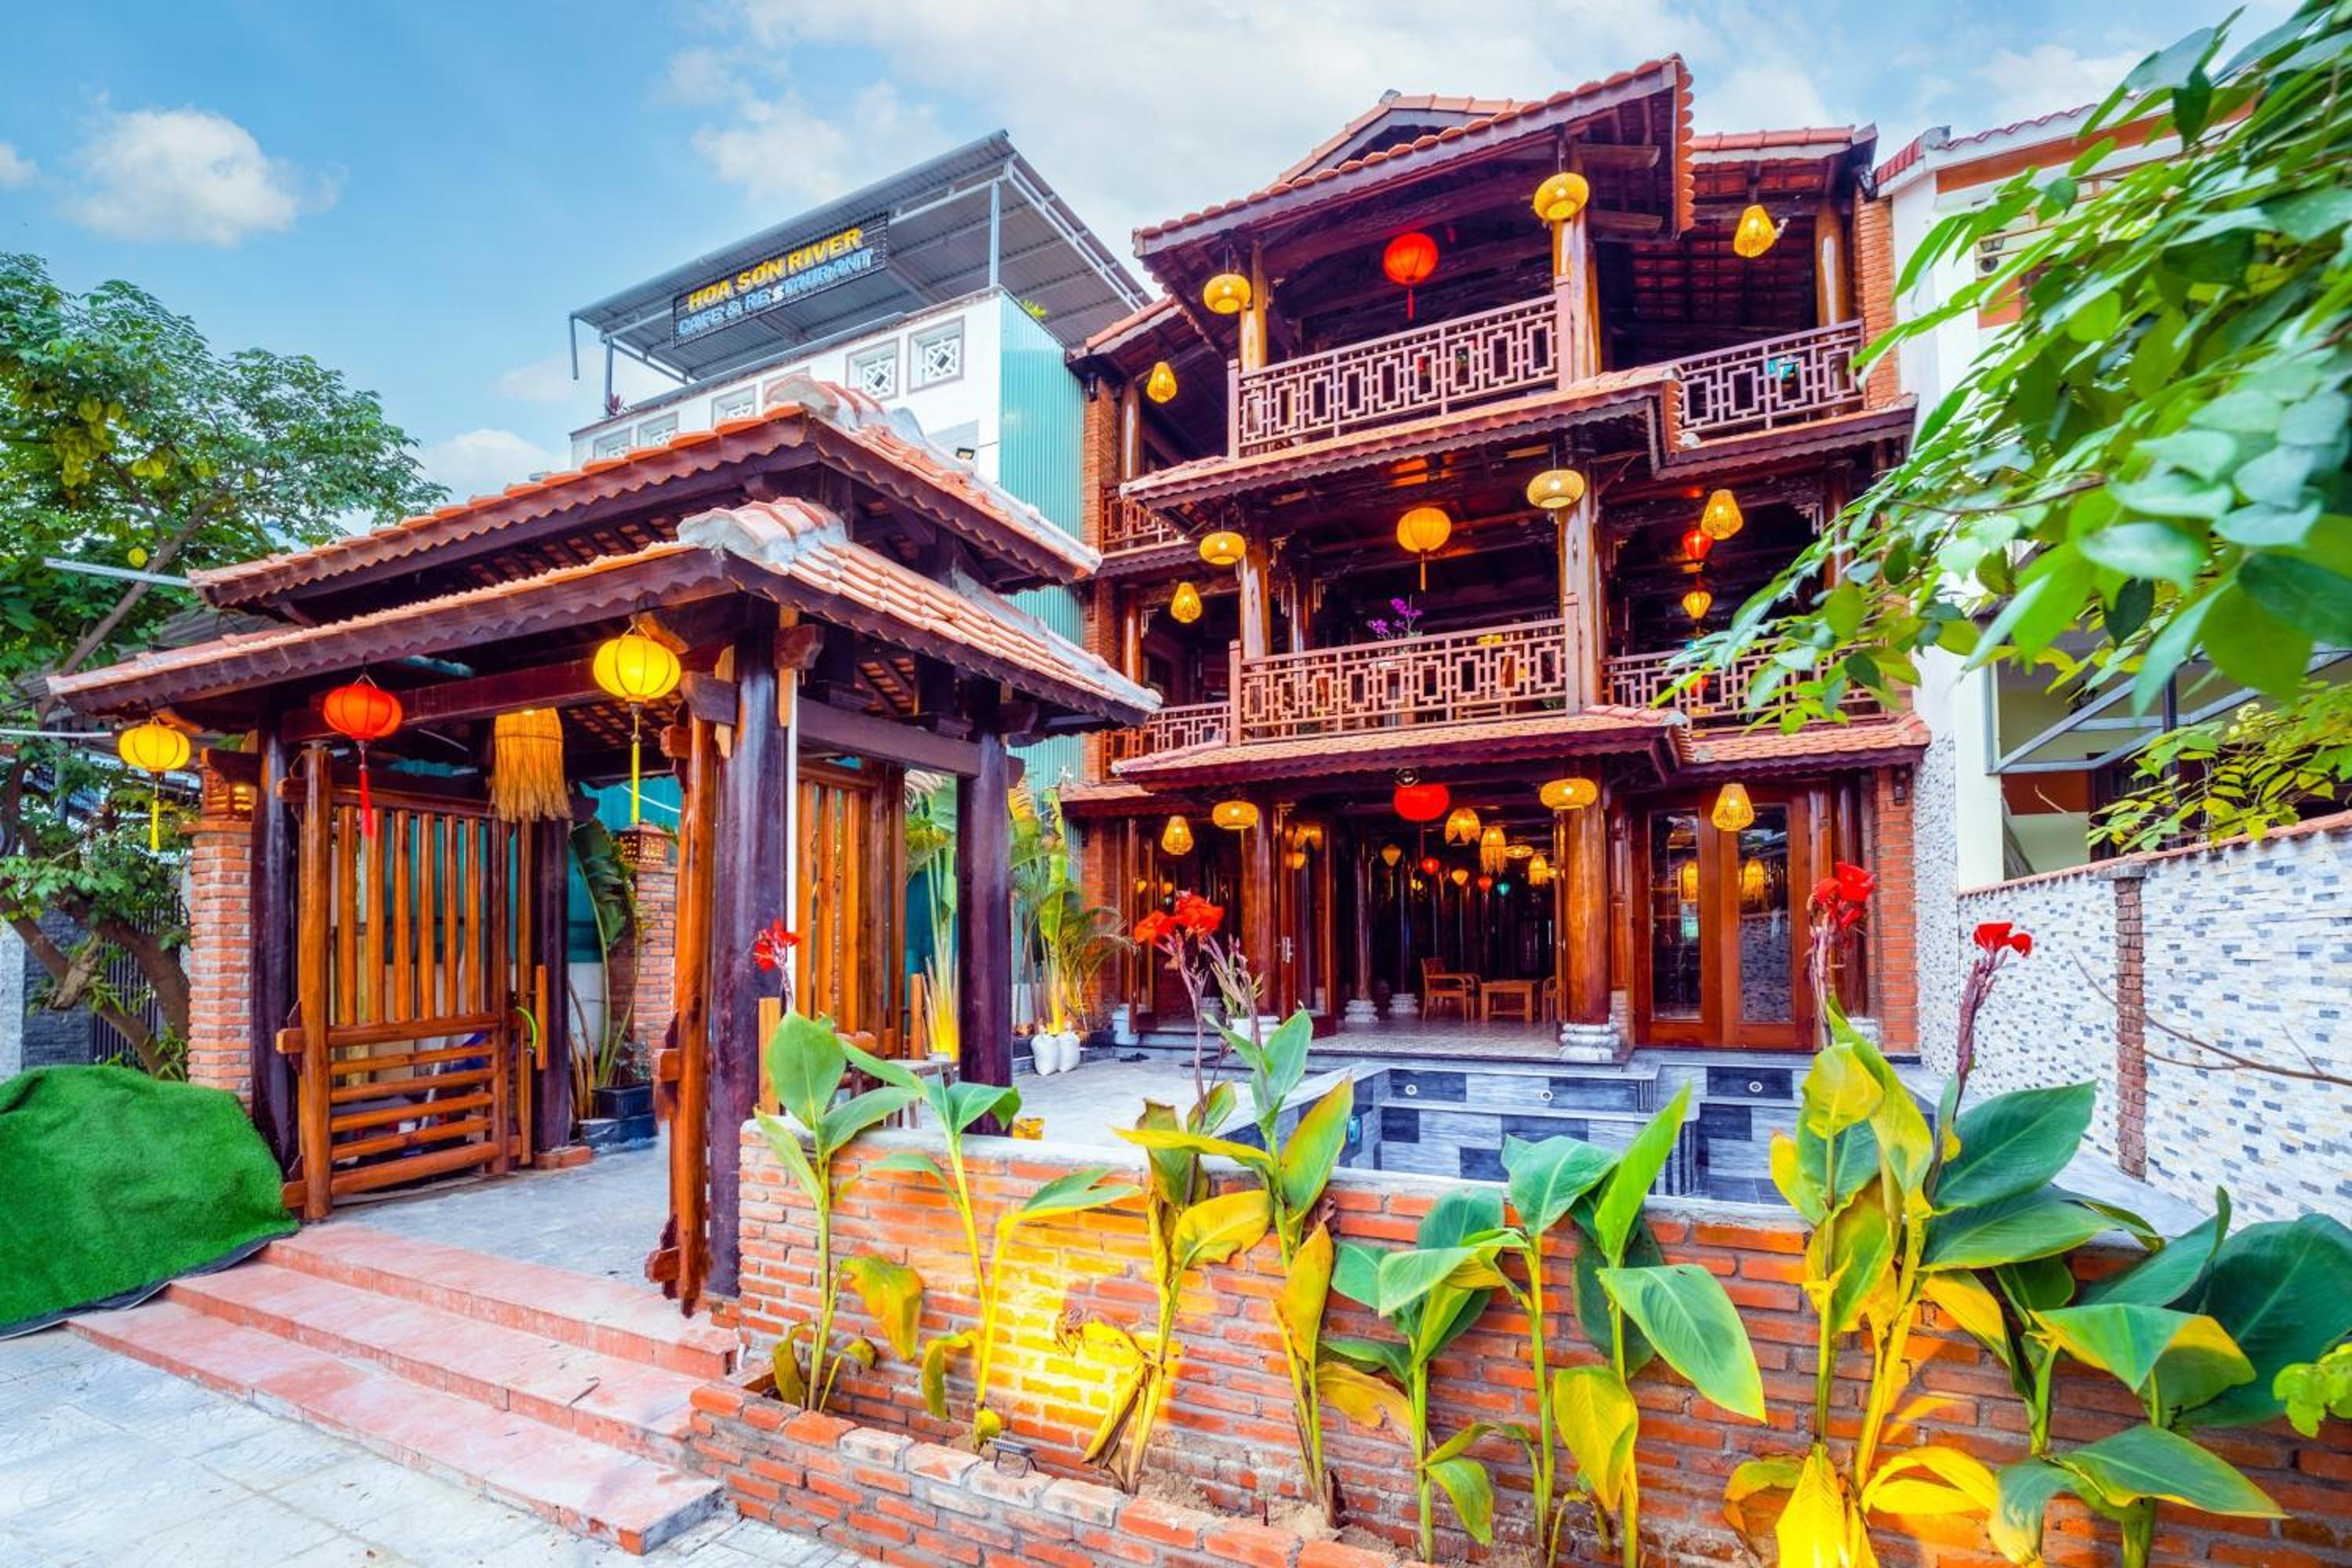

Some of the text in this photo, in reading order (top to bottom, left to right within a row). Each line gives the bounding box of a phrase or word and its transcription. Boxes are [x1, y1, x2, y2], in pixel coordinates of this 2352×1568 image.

[688, 280, 734, 313] HOA
[788, 227, 862, 273] RIVER
[677, 307, 726, 336] CAFE
[727, 299, 743, 319] &
